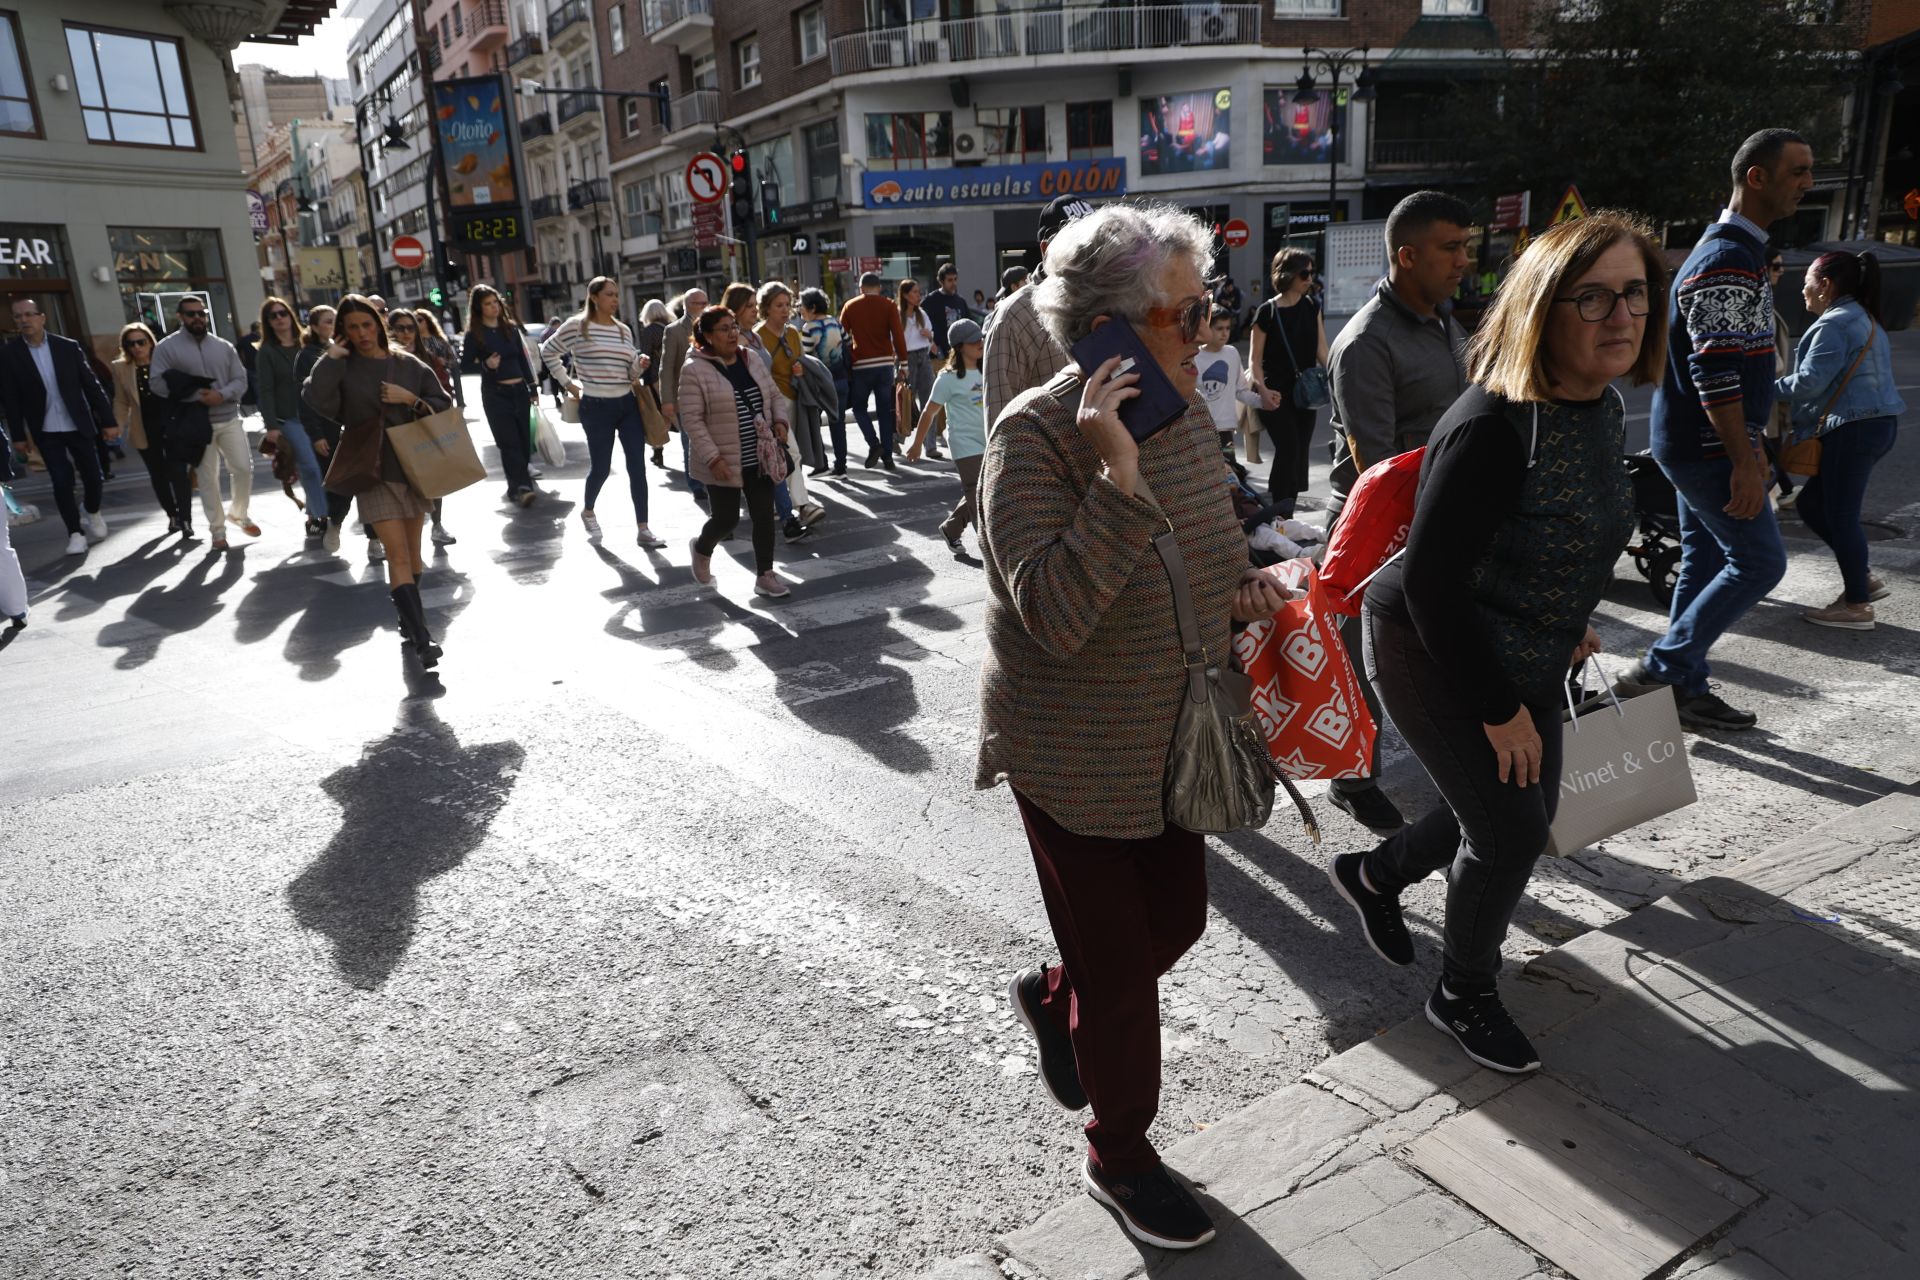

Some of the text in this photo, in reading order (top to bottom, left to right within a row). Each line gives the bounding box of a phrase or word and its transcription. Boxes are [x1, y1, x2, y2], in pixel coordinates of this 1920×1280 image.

[451, 120, 495, 141] Otoño
[903, 163, 1121, 201] auto escuelas COLÓN
[466, 217, 517, 241] 12:23
[793, 238, 807, 251] JD
[1559, 740, 1675, 799] Ninet & Co
